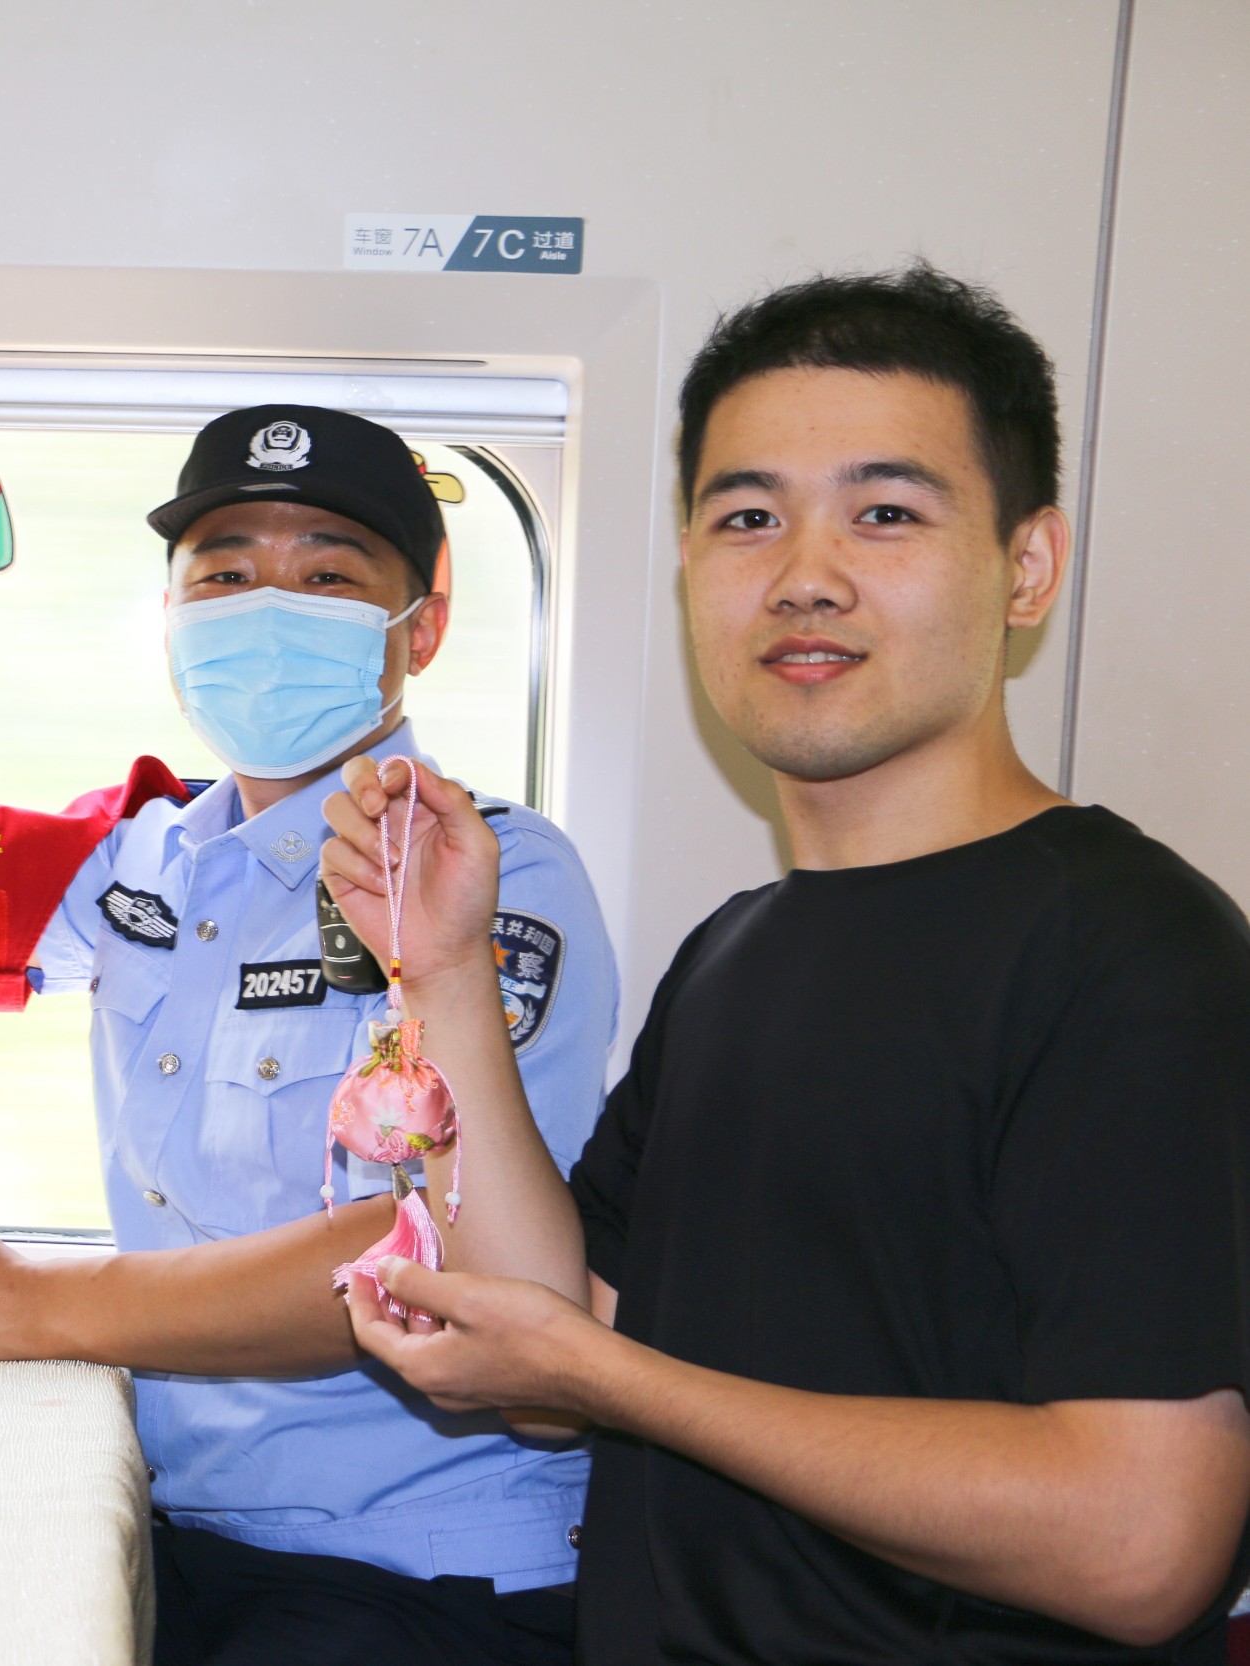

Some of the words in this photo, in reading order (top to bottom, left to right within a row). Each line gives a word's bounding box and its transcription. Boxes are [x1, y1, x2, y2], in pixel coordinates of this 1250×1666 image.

[353, 246, 393, 257] Window
[354, 227, 393, 246] 车窗
[402, 227, 445, 258] 7A
[472, 228, 526, 260] 7C
[532, 231, 575, 250] 过道
[539, 251, 567, 261] Aisle
[241, 968, 322, 998] 202457
